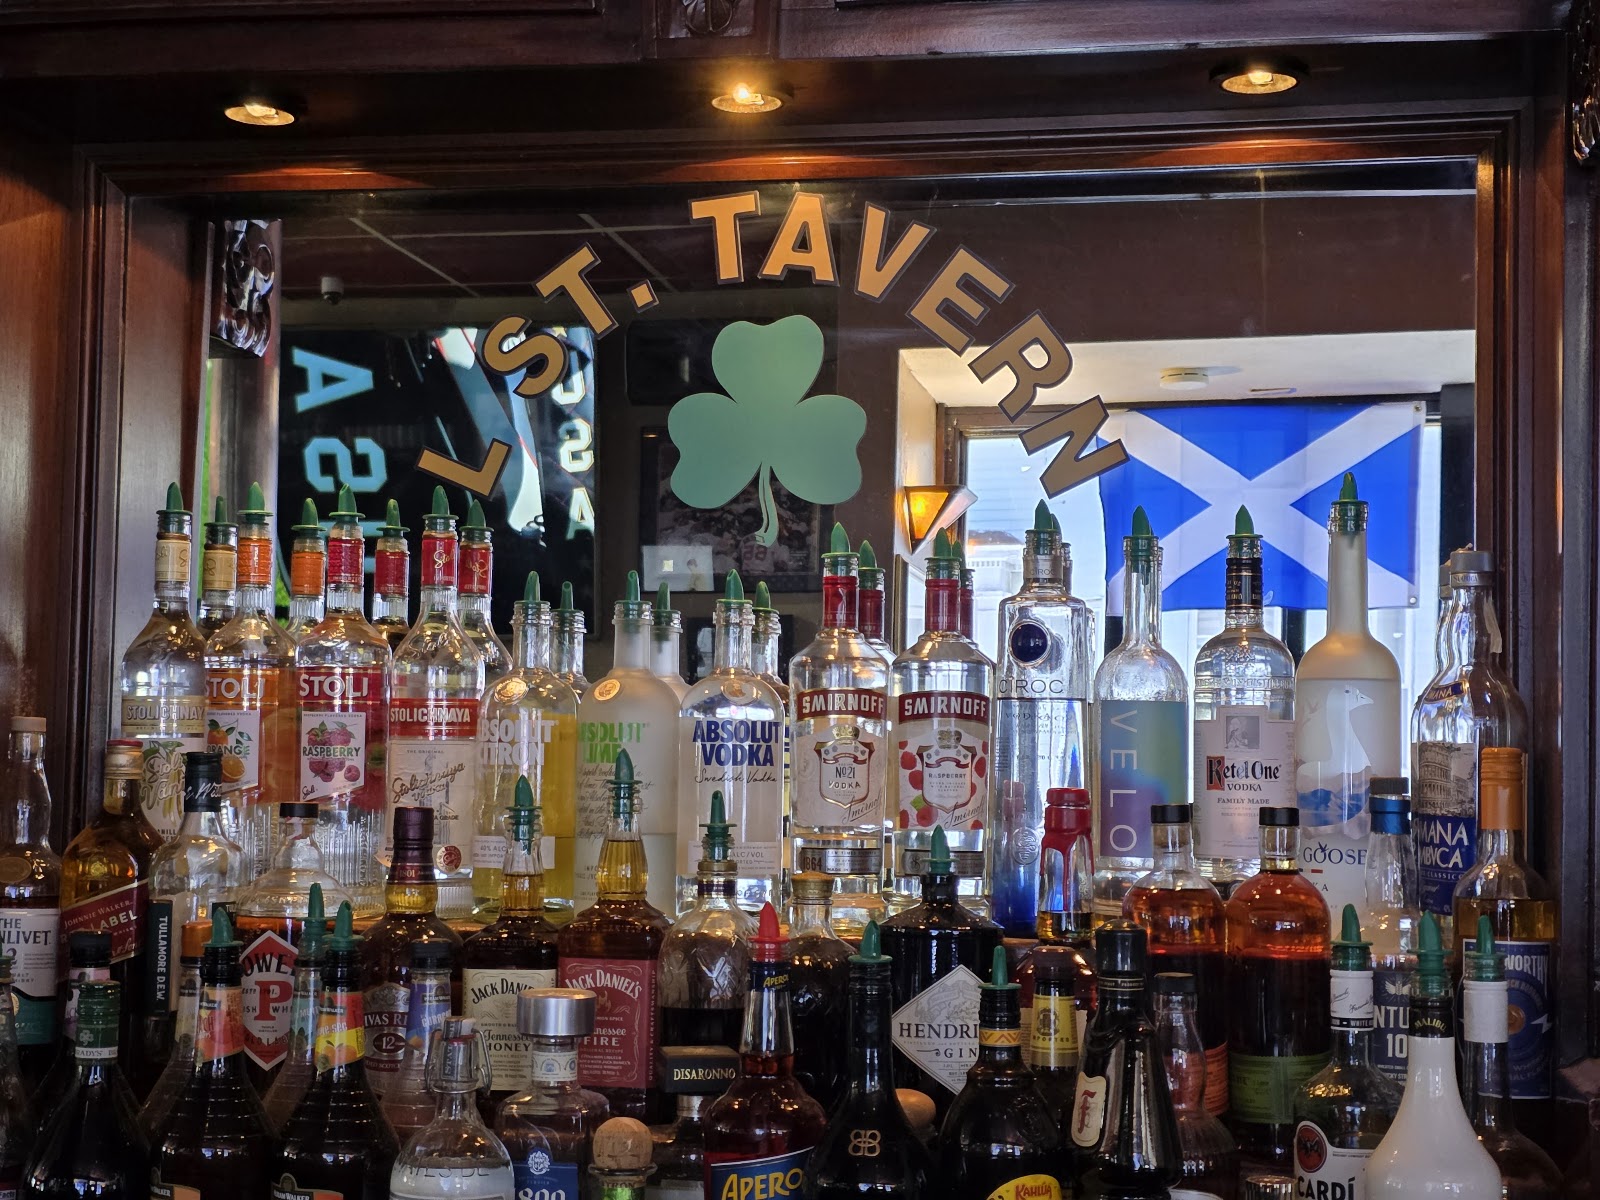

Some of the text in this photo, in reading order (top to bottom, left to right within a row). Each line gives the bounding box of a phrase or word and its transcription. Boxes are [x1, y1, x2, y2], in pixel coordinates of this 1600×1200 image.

[415, 190, 1131, 499] L ST. TAVERN
[299, 673, 369, 698] STOLI
[802, 693, 884, 714] SMIRNOFF
[904, 696, 986, 718] SMIRNOFF
[390, 707, 471, 723] STOLICHNAYA
[692, 720, 782, 743] ABSOLUT
[302, 746, 361, 758] RASPBERRY
[700, 743, 774, 767] VODKA
[1109, 709, 1138, 852] VELO
[1208, 759, 1281, 789] Ketel One
[828, 781, 861, 790] VODKA
[1227, 783, 1263, 792] VODKA
[1217, 797, 1270, 805] FAMILY MADE
[803, 856, 822, 871] 1864
[1303, 845, 1368, 865] GOOSE
[64, 900, 132, 930] JOHNNIE WALKER
[155, 915, 168, 1002] TULLAMORE D.E.W.
[241, 953, 297, 977] OWE
[565, 969, 642, 1001] JACK DANIEL'S
[763, 974, 789, 988] APEROL
[254, 980, 293, 1021] P
[471, 982, 499, 1005] JACK
[898, 1022, 979, 1039] HENDRI
[1414, 1017, 1447, 1033] MALIBU
[382, 1036, 396, 1050] 12
[484, 1029, 531, 1042] Tennessee
[583, 1036, 620, 1046] FIRE
[486, 1043, 531, 1052] HONEY
[944, 1048, 979, 1058] GIN
[673, 1068, 736, 1081] DISARONNO
[721, 1167, 804, 1200] APERO
